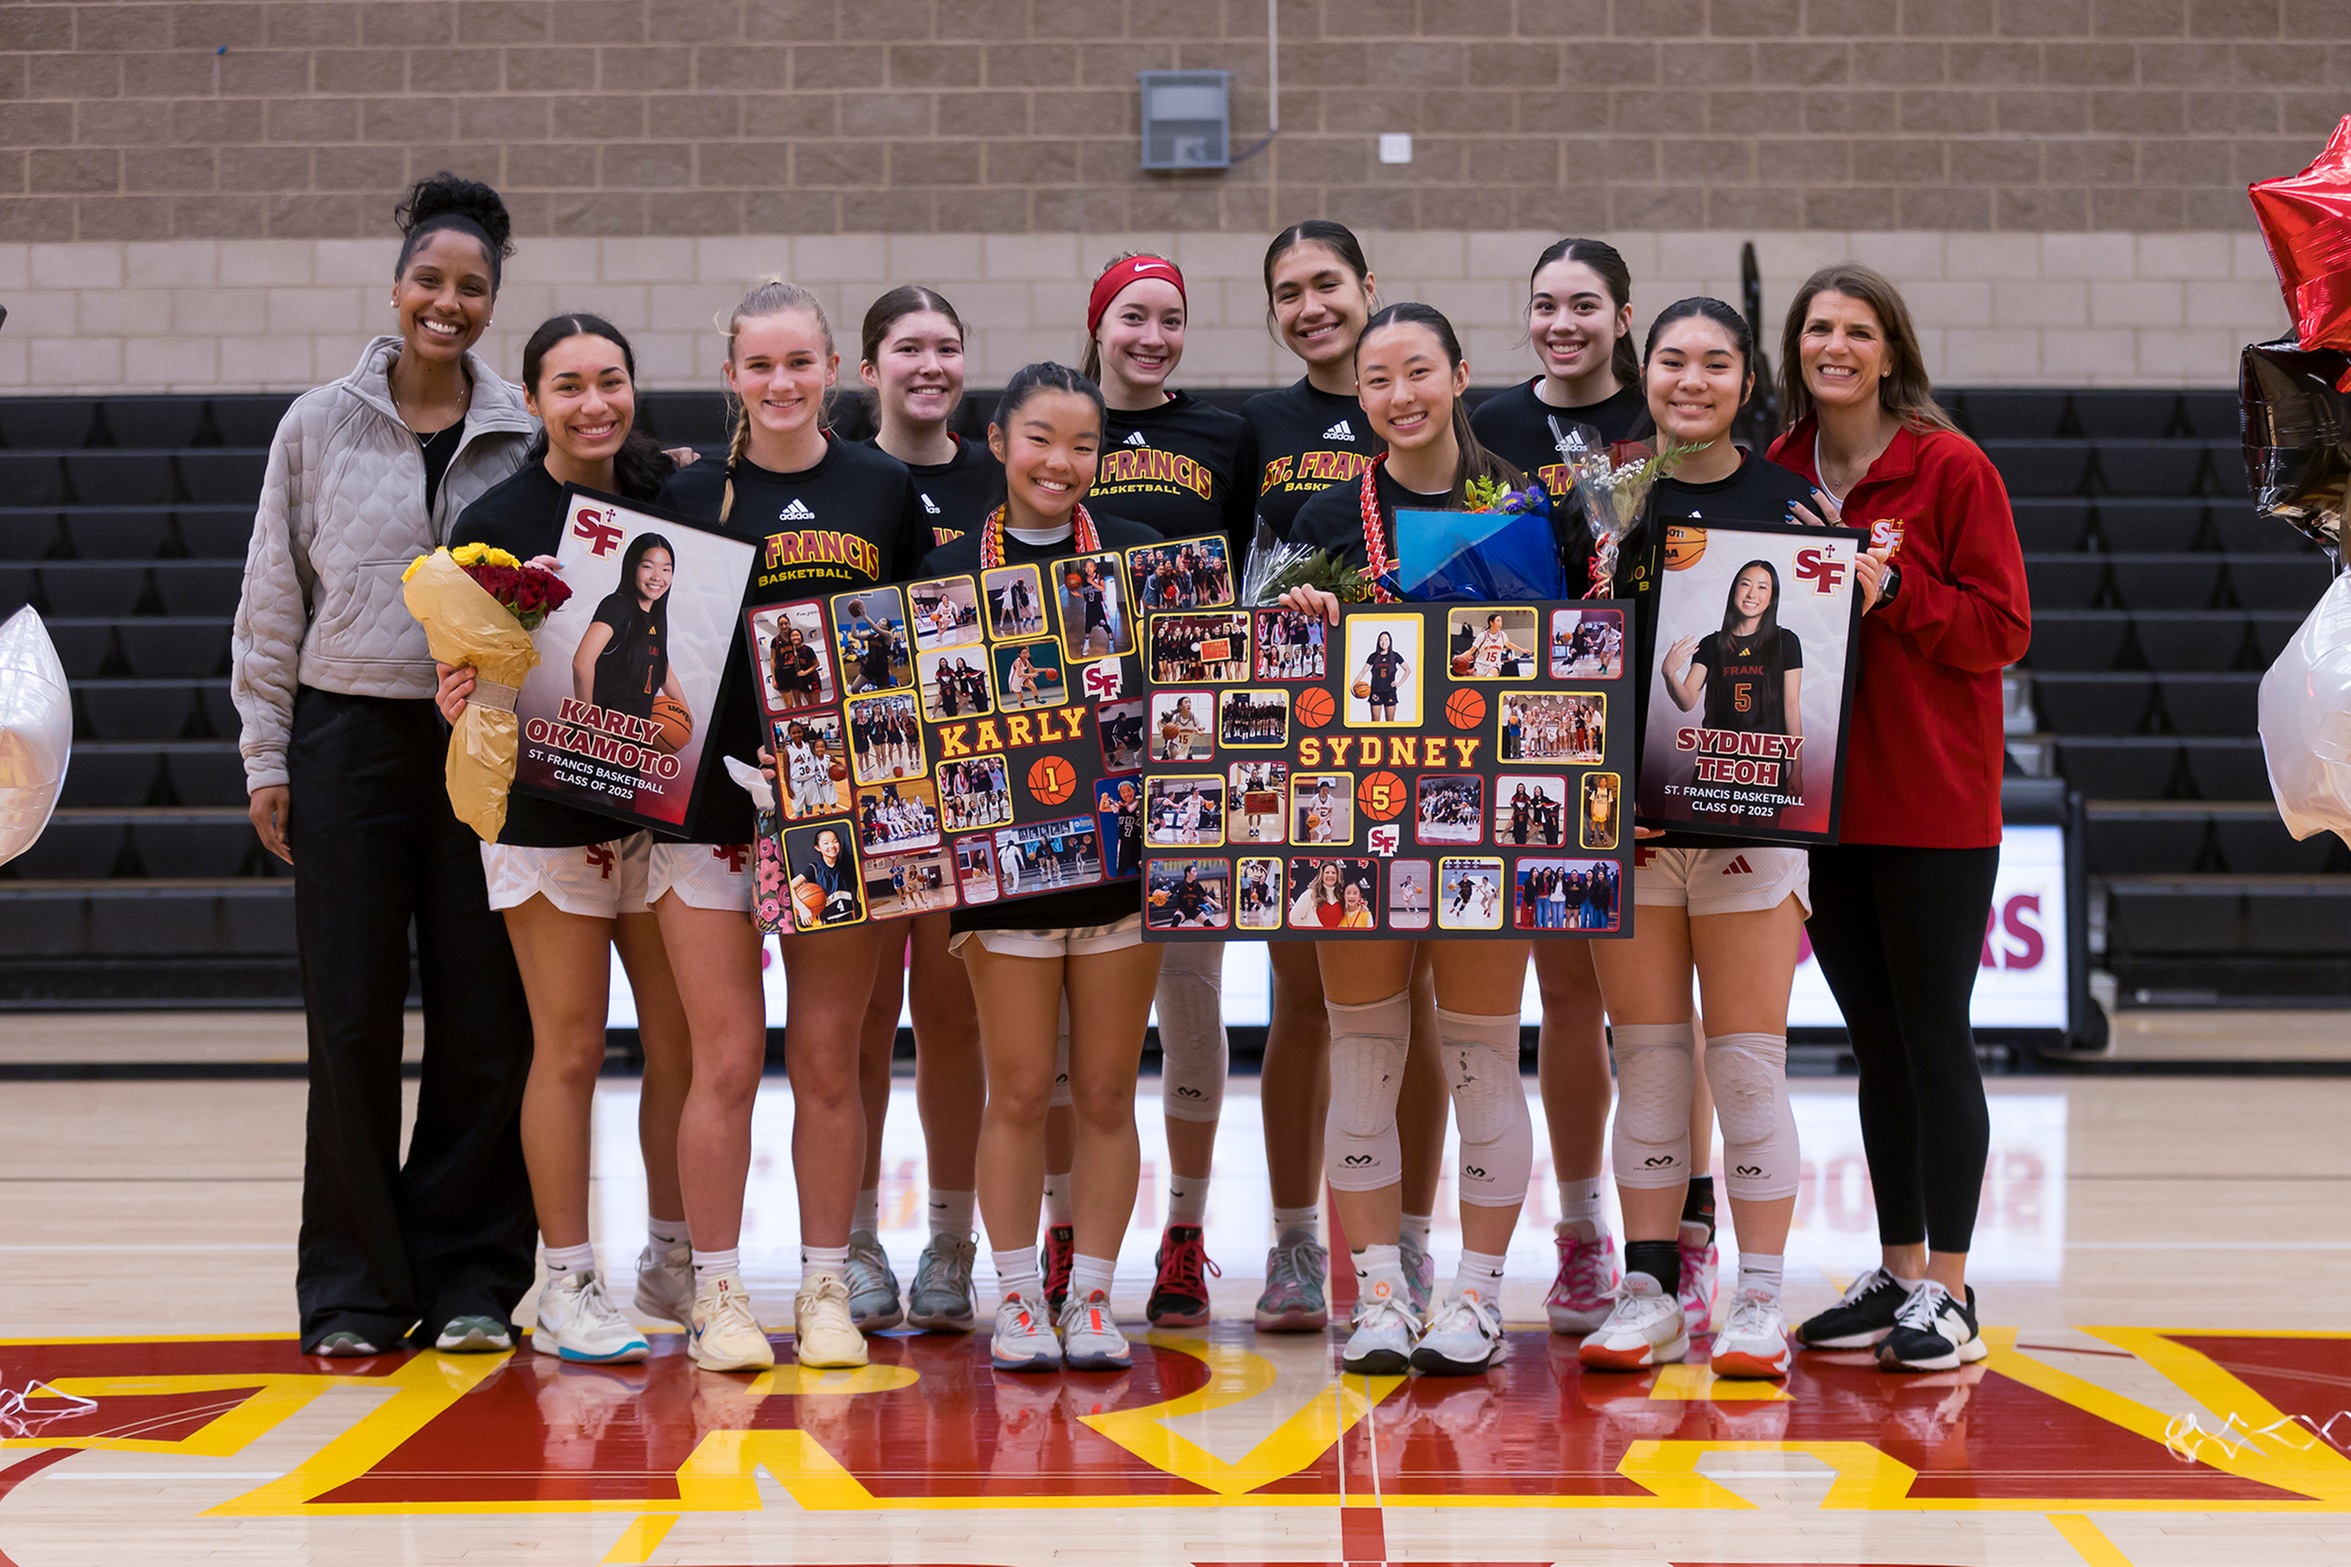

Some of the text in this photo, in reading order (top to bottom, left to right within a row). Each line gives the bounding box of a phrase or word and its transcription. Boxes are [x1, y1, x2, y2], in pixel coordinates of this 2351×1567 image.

[1323, 431, 1355, 442] adidas
[1554, 441, 1588, 453] adidas
[1101, 448, 1212, 500] FRANCIS
[1261, 450, 1371, 498] ST. FRAN
[1090, 484, 1181, 497] BASKETBALL
[779, 510, 816, 521] adidas
[572, 507, 625, 559] SF
[765, 529, 880, 581] FRANCIS
[758, 568, 852, 588] BASKETBALL
[1794, 547, 1847, 595] SF
[1085, 667, 1119, 698] SF
[1723, 664, 1764, 677] FRANC
[1734, 683, 1752, 713] 5
[558, 698, 664, 746] KARLY
[938, 706, 1088, 759] KARLY
[525, 717, 681, 780] OKAMOTO
[1298, 735, 1481, 768] SYDNEY
[1676, 727, 1805, 760] SYDNEY
[528, 748, 665, 796] ST. FRANCIS BASKETBALL
[553, 769, 634, 800] CLASS OF 2025
[1045, 766, 1060, 792] 1
[1695, 756, 1780, 787] TEOH
[1371, 782, 1391, 812] 5
[1664, 784, 1805, 807] ST. FRANCIS BASKETBALL
[1691, 800, 1774, 818] CLASS OF 2025
[1124, 824, 1134, 838] 7
[1371, 829, 1397, 854] SF
[836, 899, 845, 912] 4
